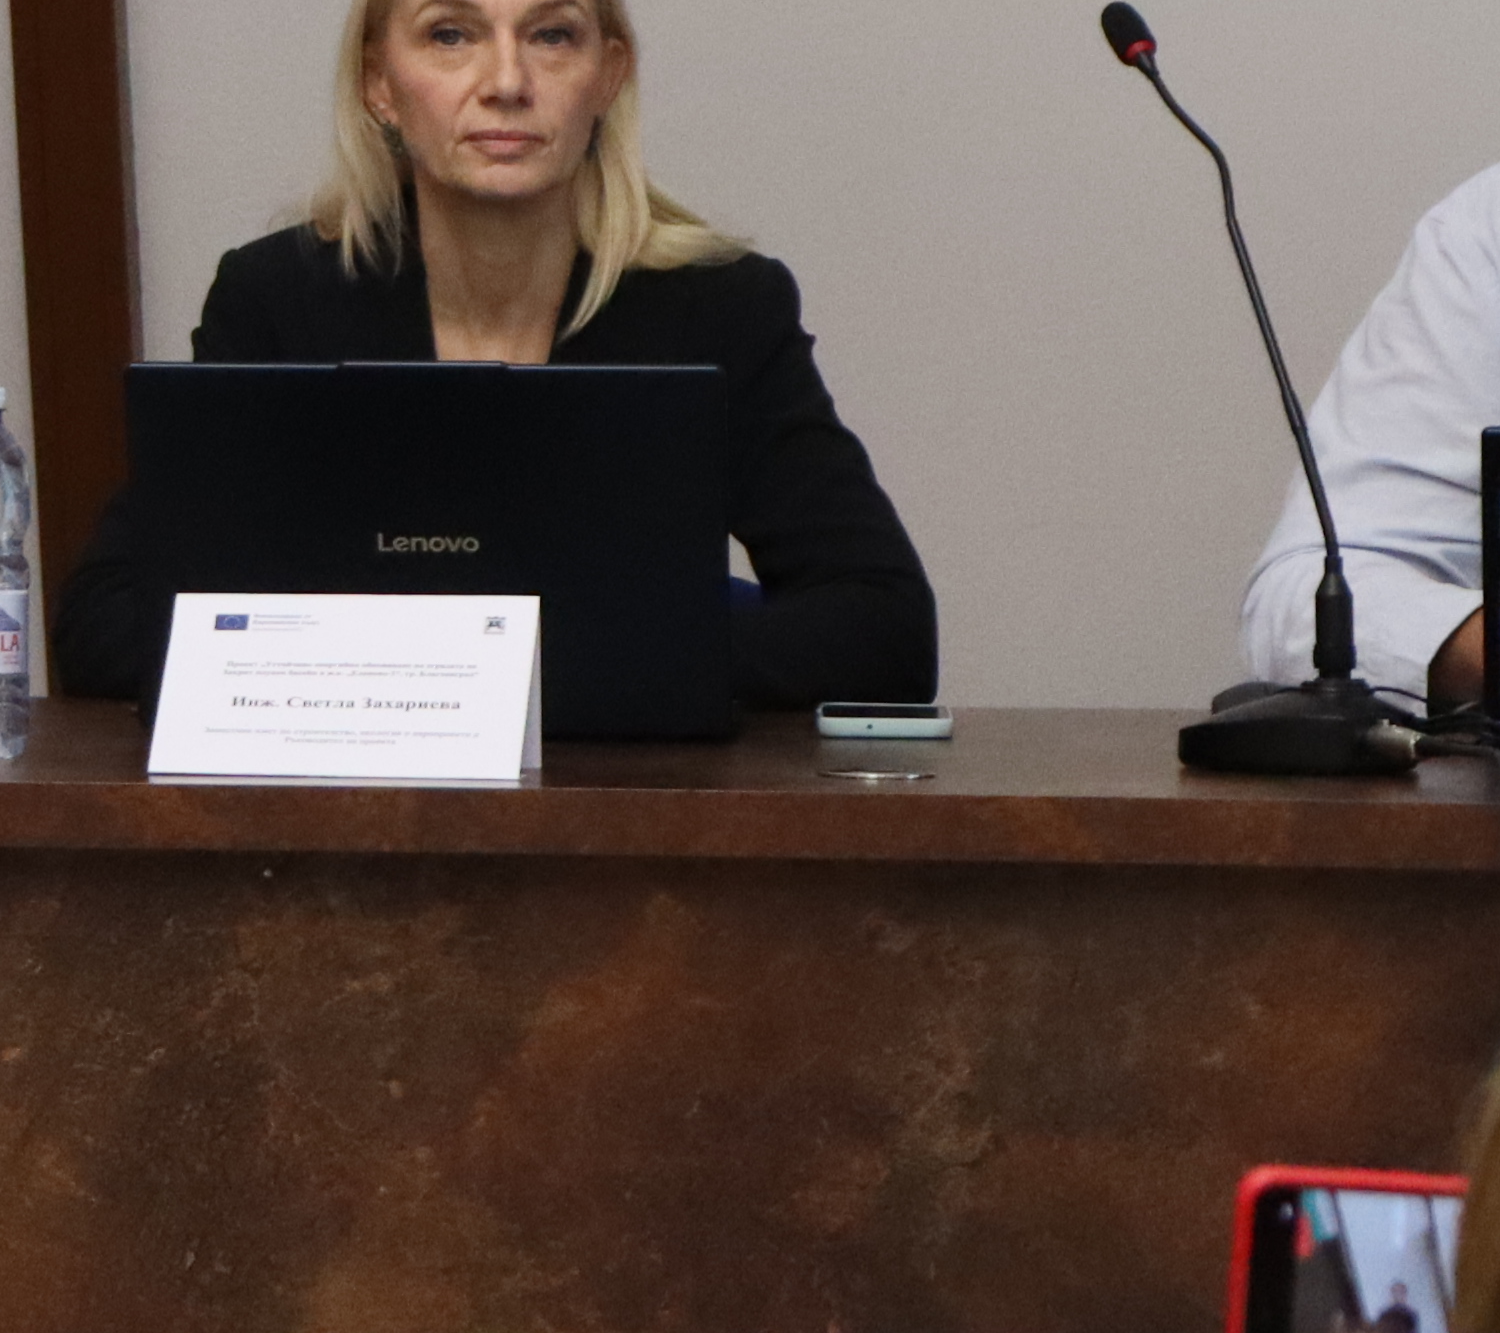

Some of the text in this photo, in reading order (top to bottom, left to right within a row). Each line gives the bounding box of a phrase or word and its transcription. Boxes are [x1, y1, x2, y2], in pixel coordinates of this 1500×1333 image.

[376, 532, 480, 552] Lenovo
[231, 695, 462, 712] Инж. Светла Захариева
